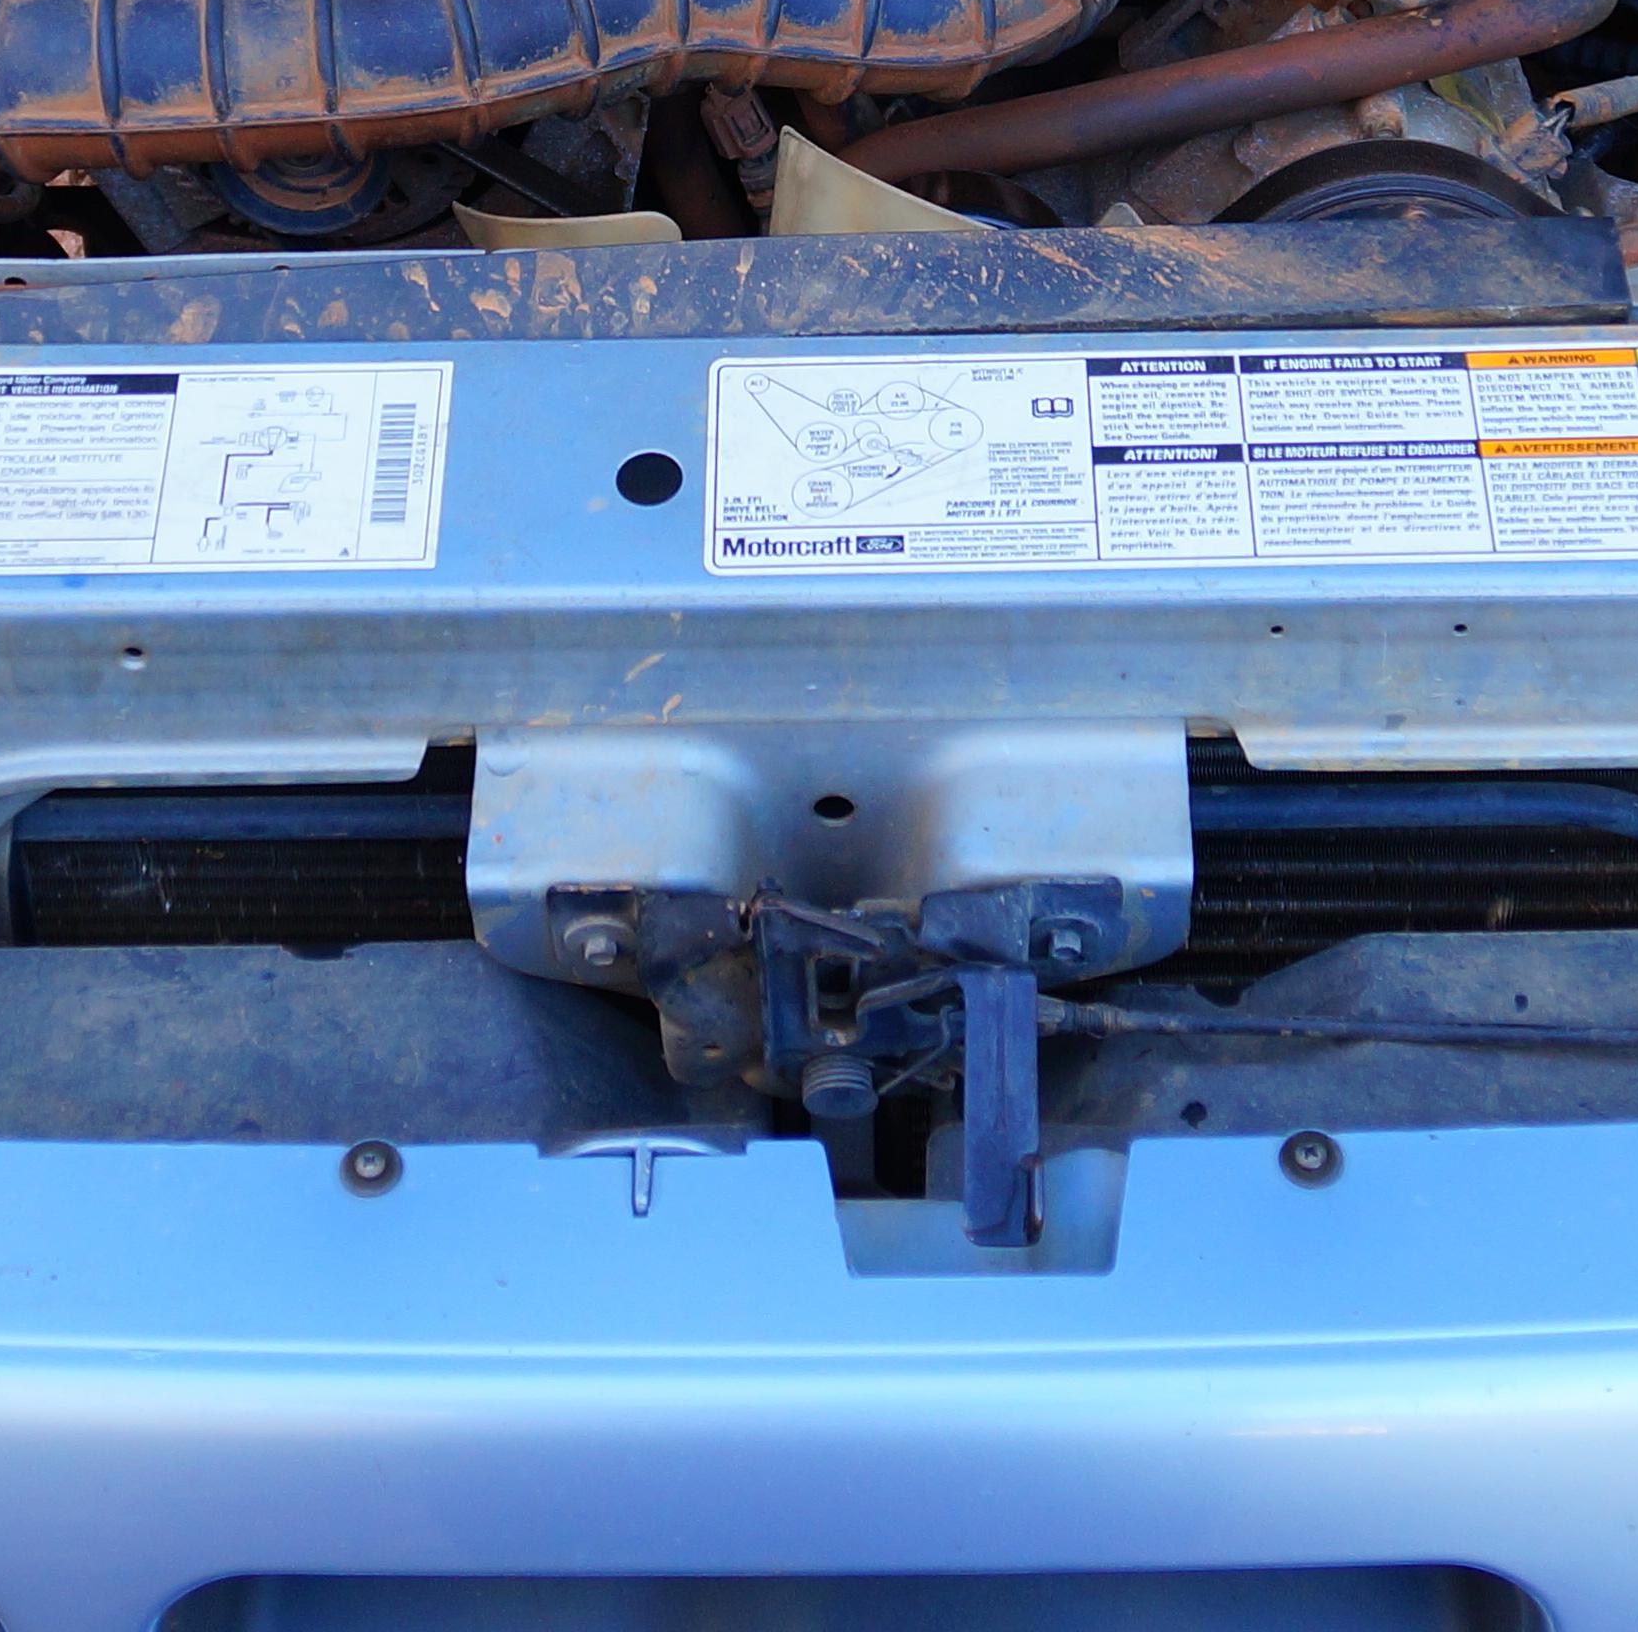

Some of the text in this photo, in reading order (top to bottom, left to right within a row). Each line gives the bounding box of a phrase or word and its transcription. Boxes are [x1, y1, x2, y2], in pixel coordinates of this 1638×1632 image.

[1263, 356, 1443, 369] IF ENGINE FAILS TO START
[1523, 354, 1596, 364] WARNING
[1119, 359, 1206, 372] ATTENTION
[14, 376, 41, 384] Motor
[42, 376, 87, 385] Company
[10, 384, 50, 393] VEHICLE
[51, 384, 119, 393] INFORMATION
[1251, 447, 1266, 458] SI
[1267, 447, 1282, 458] LE
[1284, 446, 1337, 457] MOTEUR
[1338, 445, 1386, 457] REFUSE
[1387, 445, 1405, 456] DE
[1511, 441, 1638, 453] AVERTISSEMENT
[1123, 447, 1218, 461] ATTENTION!
[946, 500, 995, 508] PARCOURS
[1017, 499, 1026, 507] LA
[722, 514, 787, 522] INSTALLATION
[722, 535, 853, 557] Motorcraft
